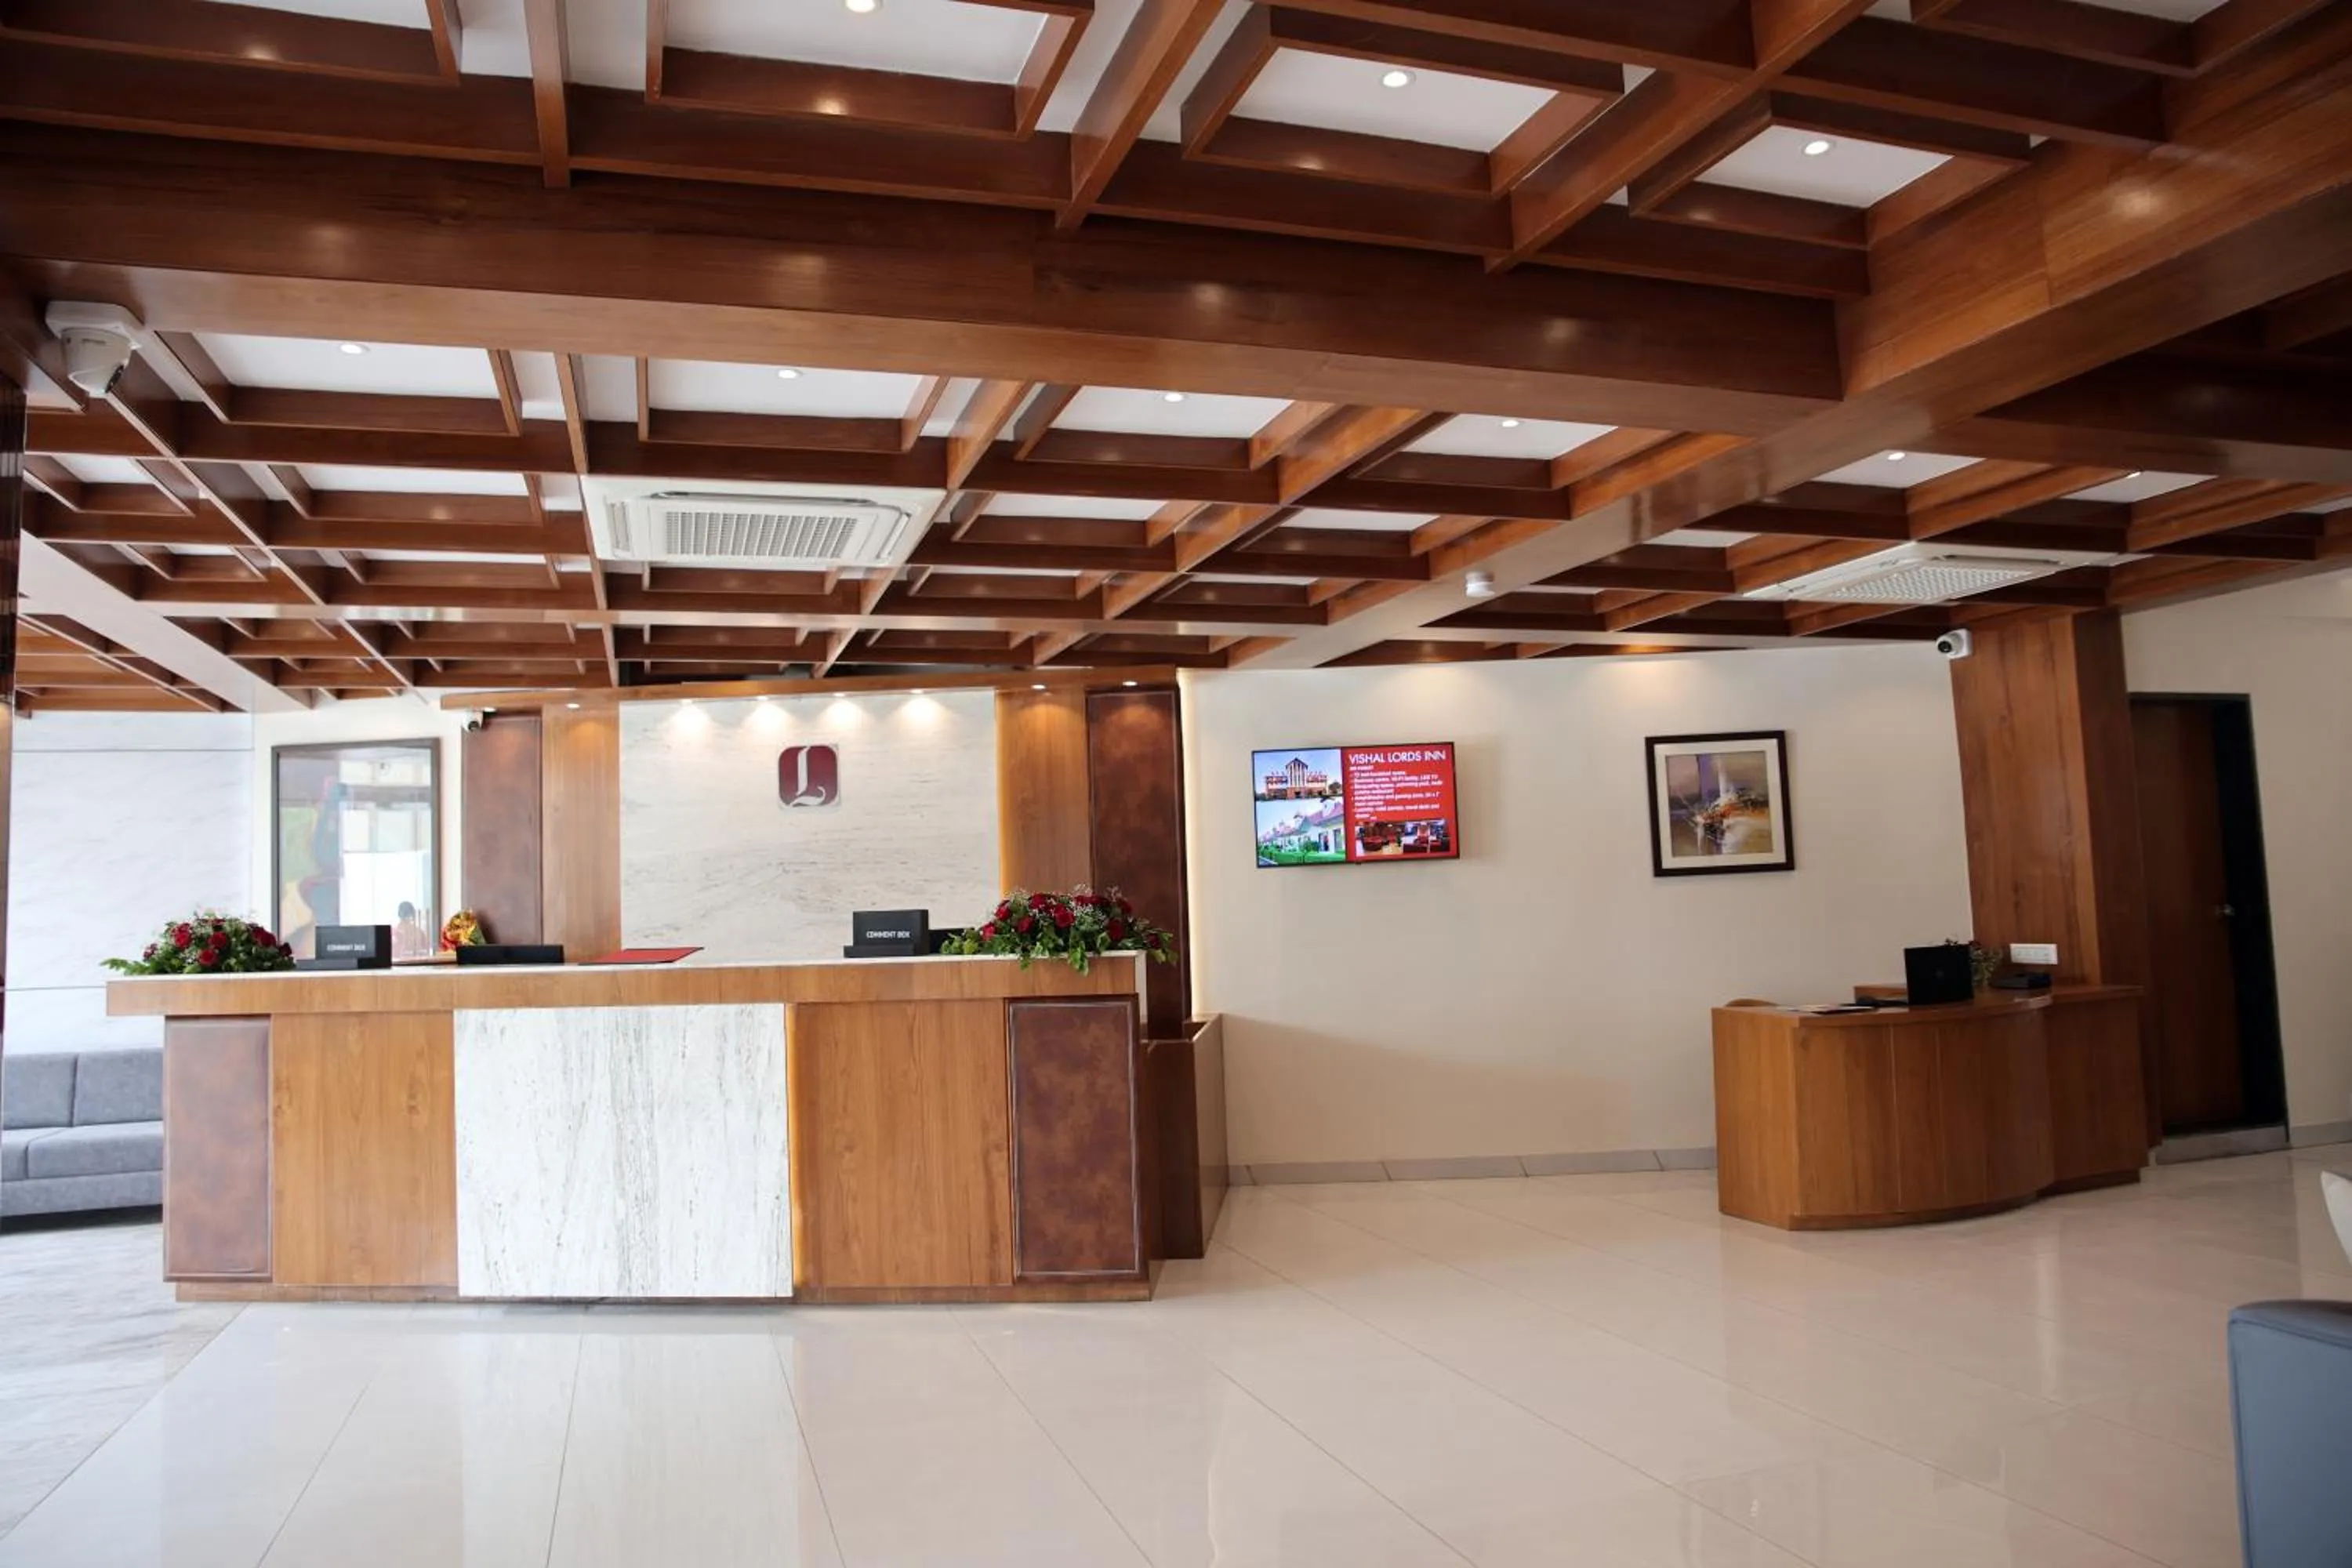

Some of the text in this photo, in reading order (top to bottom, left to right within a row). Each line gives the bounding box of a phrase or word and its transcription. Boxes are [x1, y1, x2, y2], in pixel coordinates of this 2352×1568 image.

[1348, 750, 1446, 764] VISHAL LORDS INN
